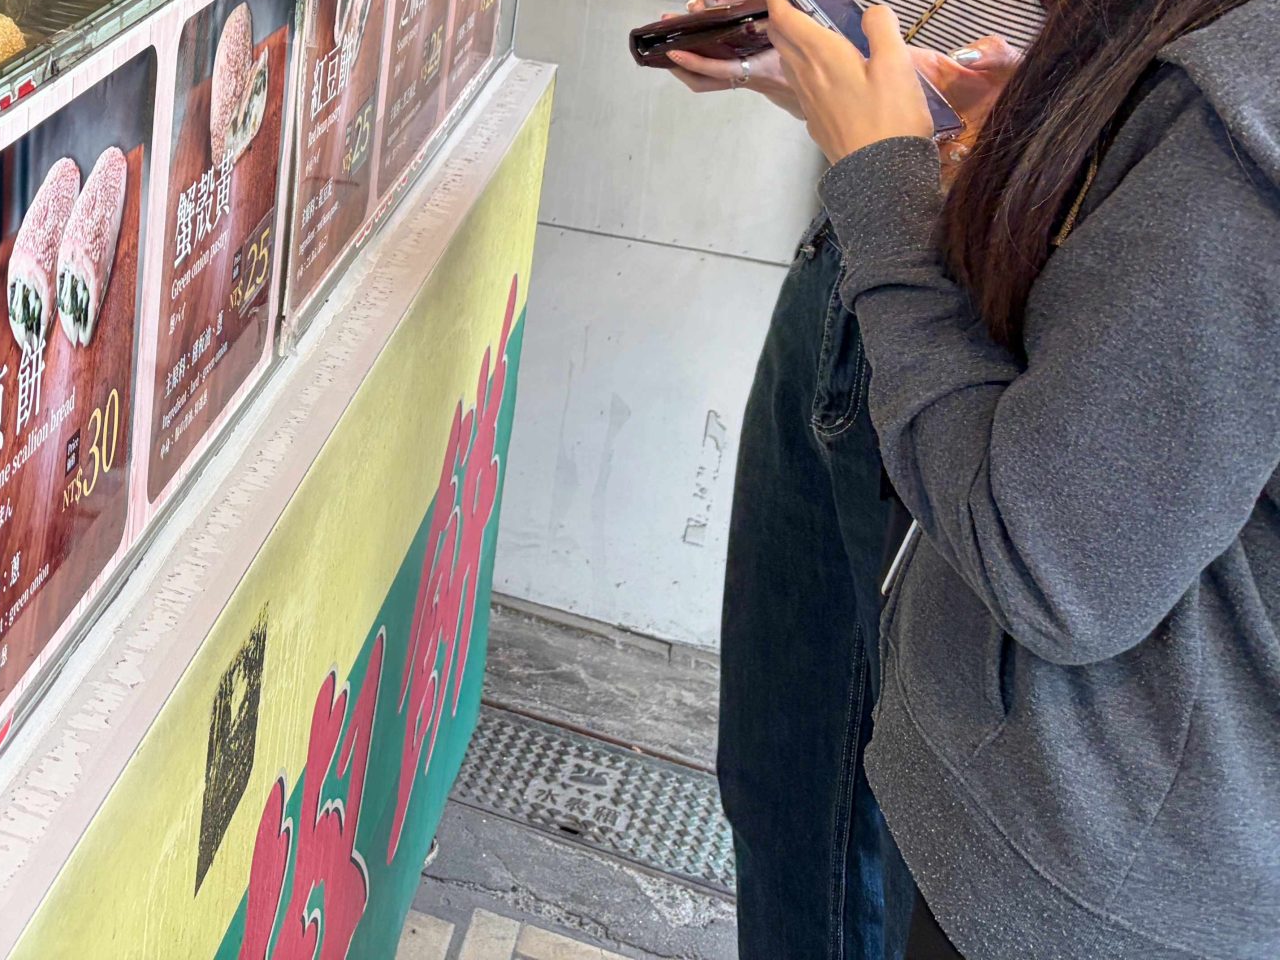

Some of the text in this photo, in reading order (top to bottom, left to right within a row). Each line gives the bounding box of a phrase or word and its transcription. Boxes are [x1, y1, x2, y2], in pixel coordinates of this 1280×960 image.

[311, 28, 354, 120] 紅豆餅
[352, 104, 372, 165] 25
[174, 149, 234, 269] 蟹殼黃
[171, 228, 230, 300] Green onion pastry
[243, 227, 270, 301] 25
[12, 422, 49, 474] scallion
[50, 386, 76, 433] bread
[61, 388, 119, 513] NT$ 30
[8, 589, 29, 626] green
[29, 563, 50, 595] onion
